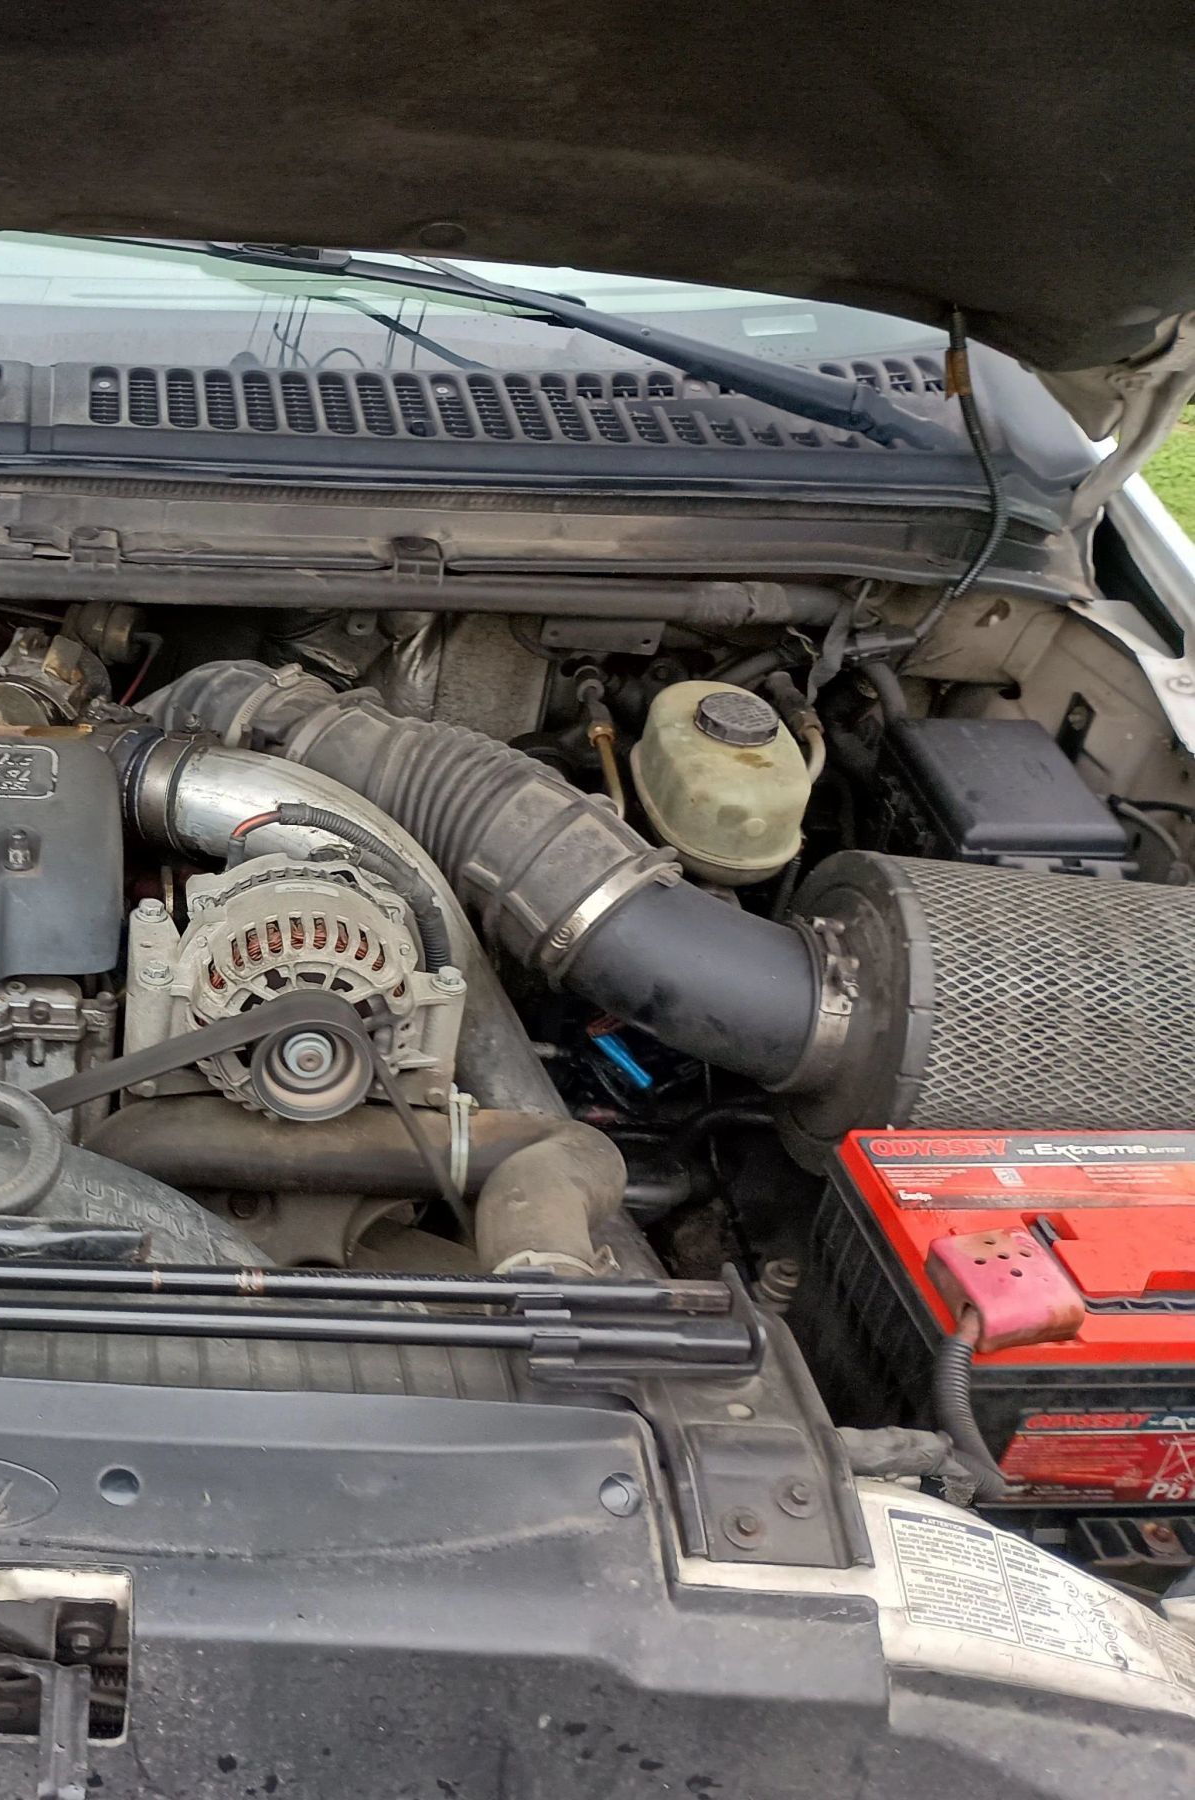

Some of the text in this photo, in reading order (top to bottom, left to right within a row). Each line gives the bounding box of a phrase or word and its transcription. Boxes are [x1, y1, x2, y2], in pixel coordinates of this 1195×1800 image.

[869, 1138, 1008, 1157] ODYSSEY
[1034, 1143, 1148, 1162] Extreme
[58, 1169, 188, 1242] AUTION
